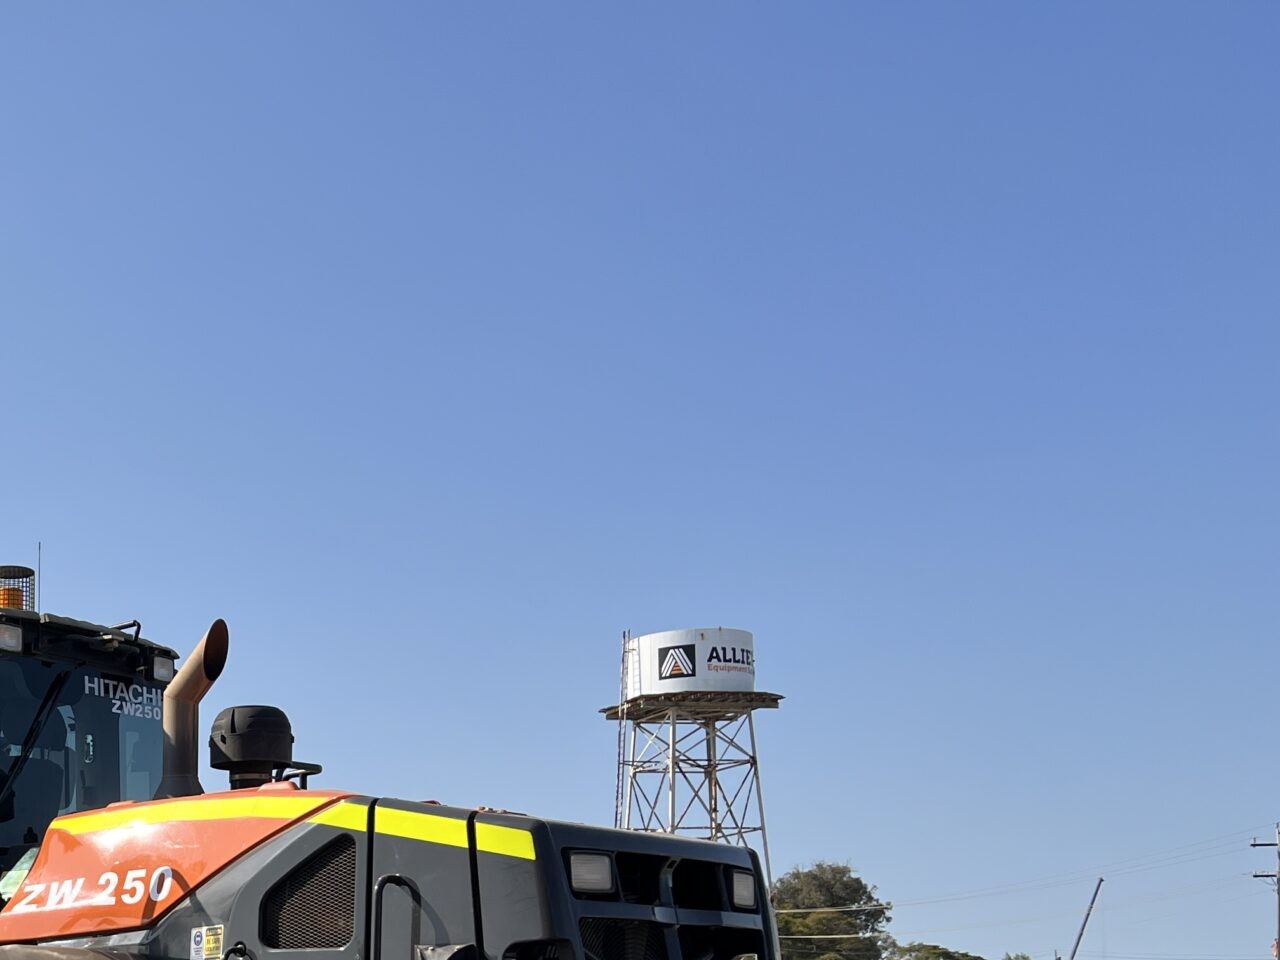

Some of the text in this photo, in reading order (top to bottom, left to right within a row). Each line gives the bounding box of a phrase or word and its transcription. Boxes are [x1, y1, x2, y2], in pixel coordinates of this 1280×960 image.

[707, 646, 755, 666] ALLIE
[84, 675, 162, 707] HITACHI
[111, 699, 162, 721] ZW250
[11, 866, 173, 912] ZW 250
